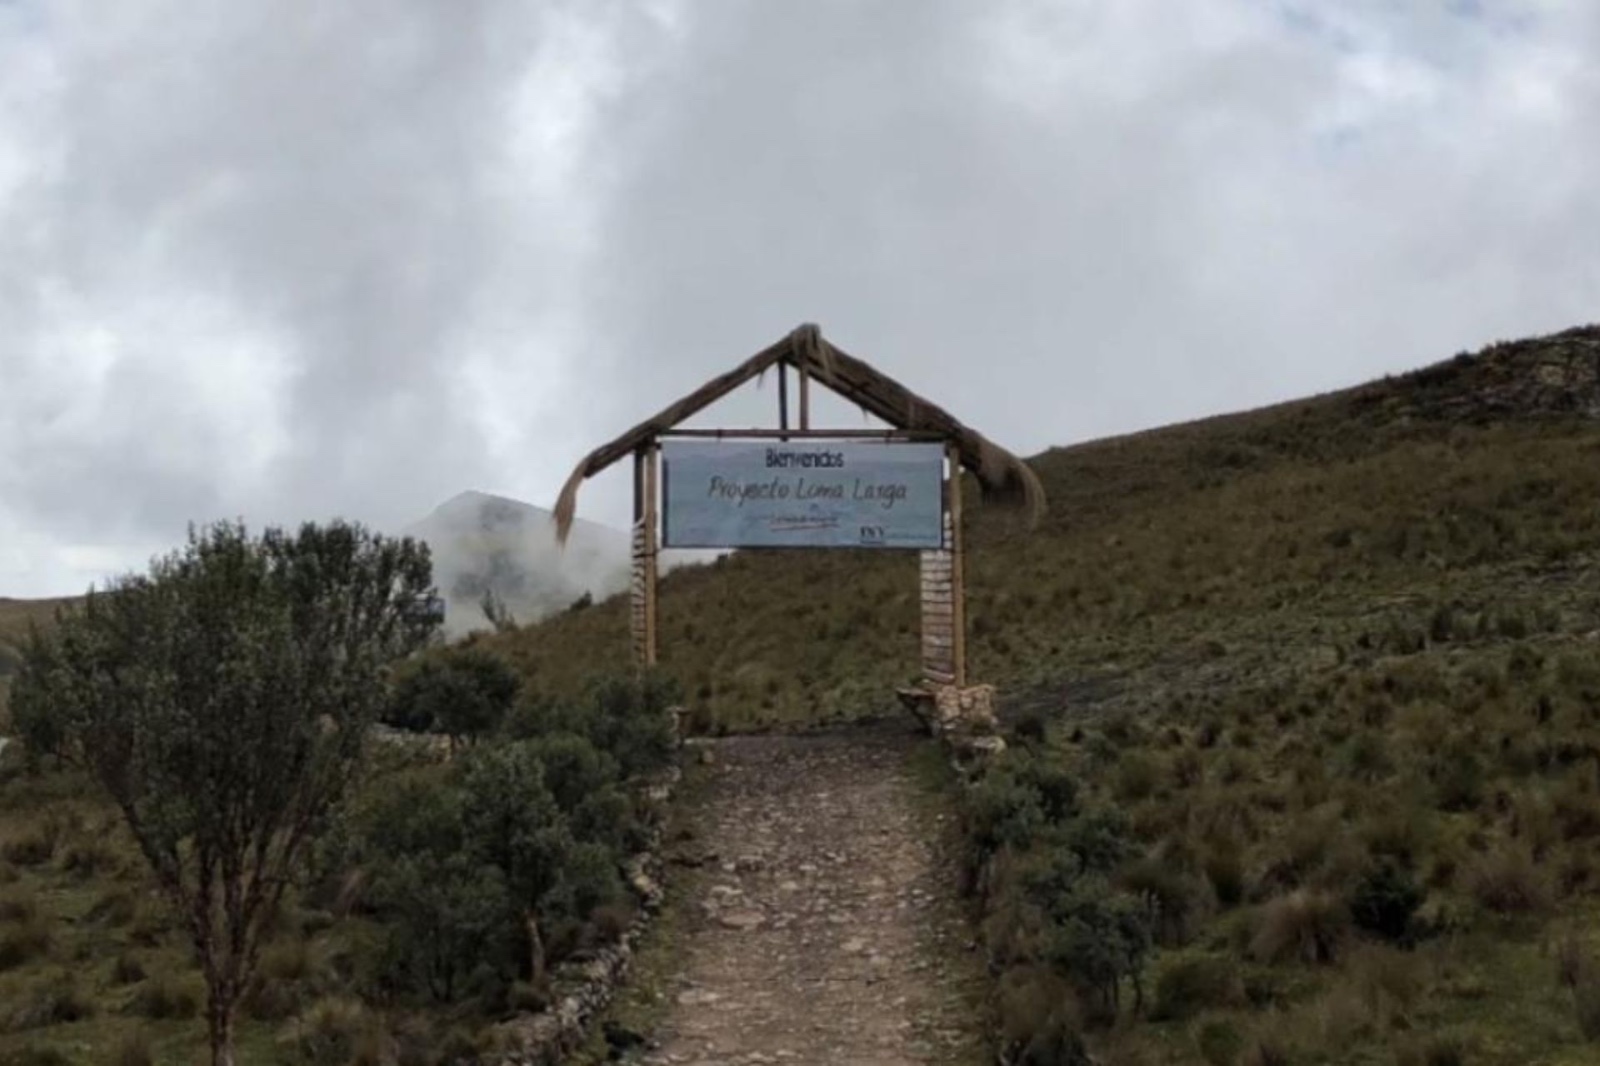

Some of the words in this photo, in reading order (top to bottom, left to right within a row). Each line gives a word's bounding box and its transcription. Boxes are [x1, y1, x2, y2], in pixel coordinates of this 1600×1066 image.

[766, 449, 844, 468] Bienvenidos
[709, 476, 789, 507] Proyecto
[796, 477, 843, 499] Loma
[853, 479, 906, 508] Larga
